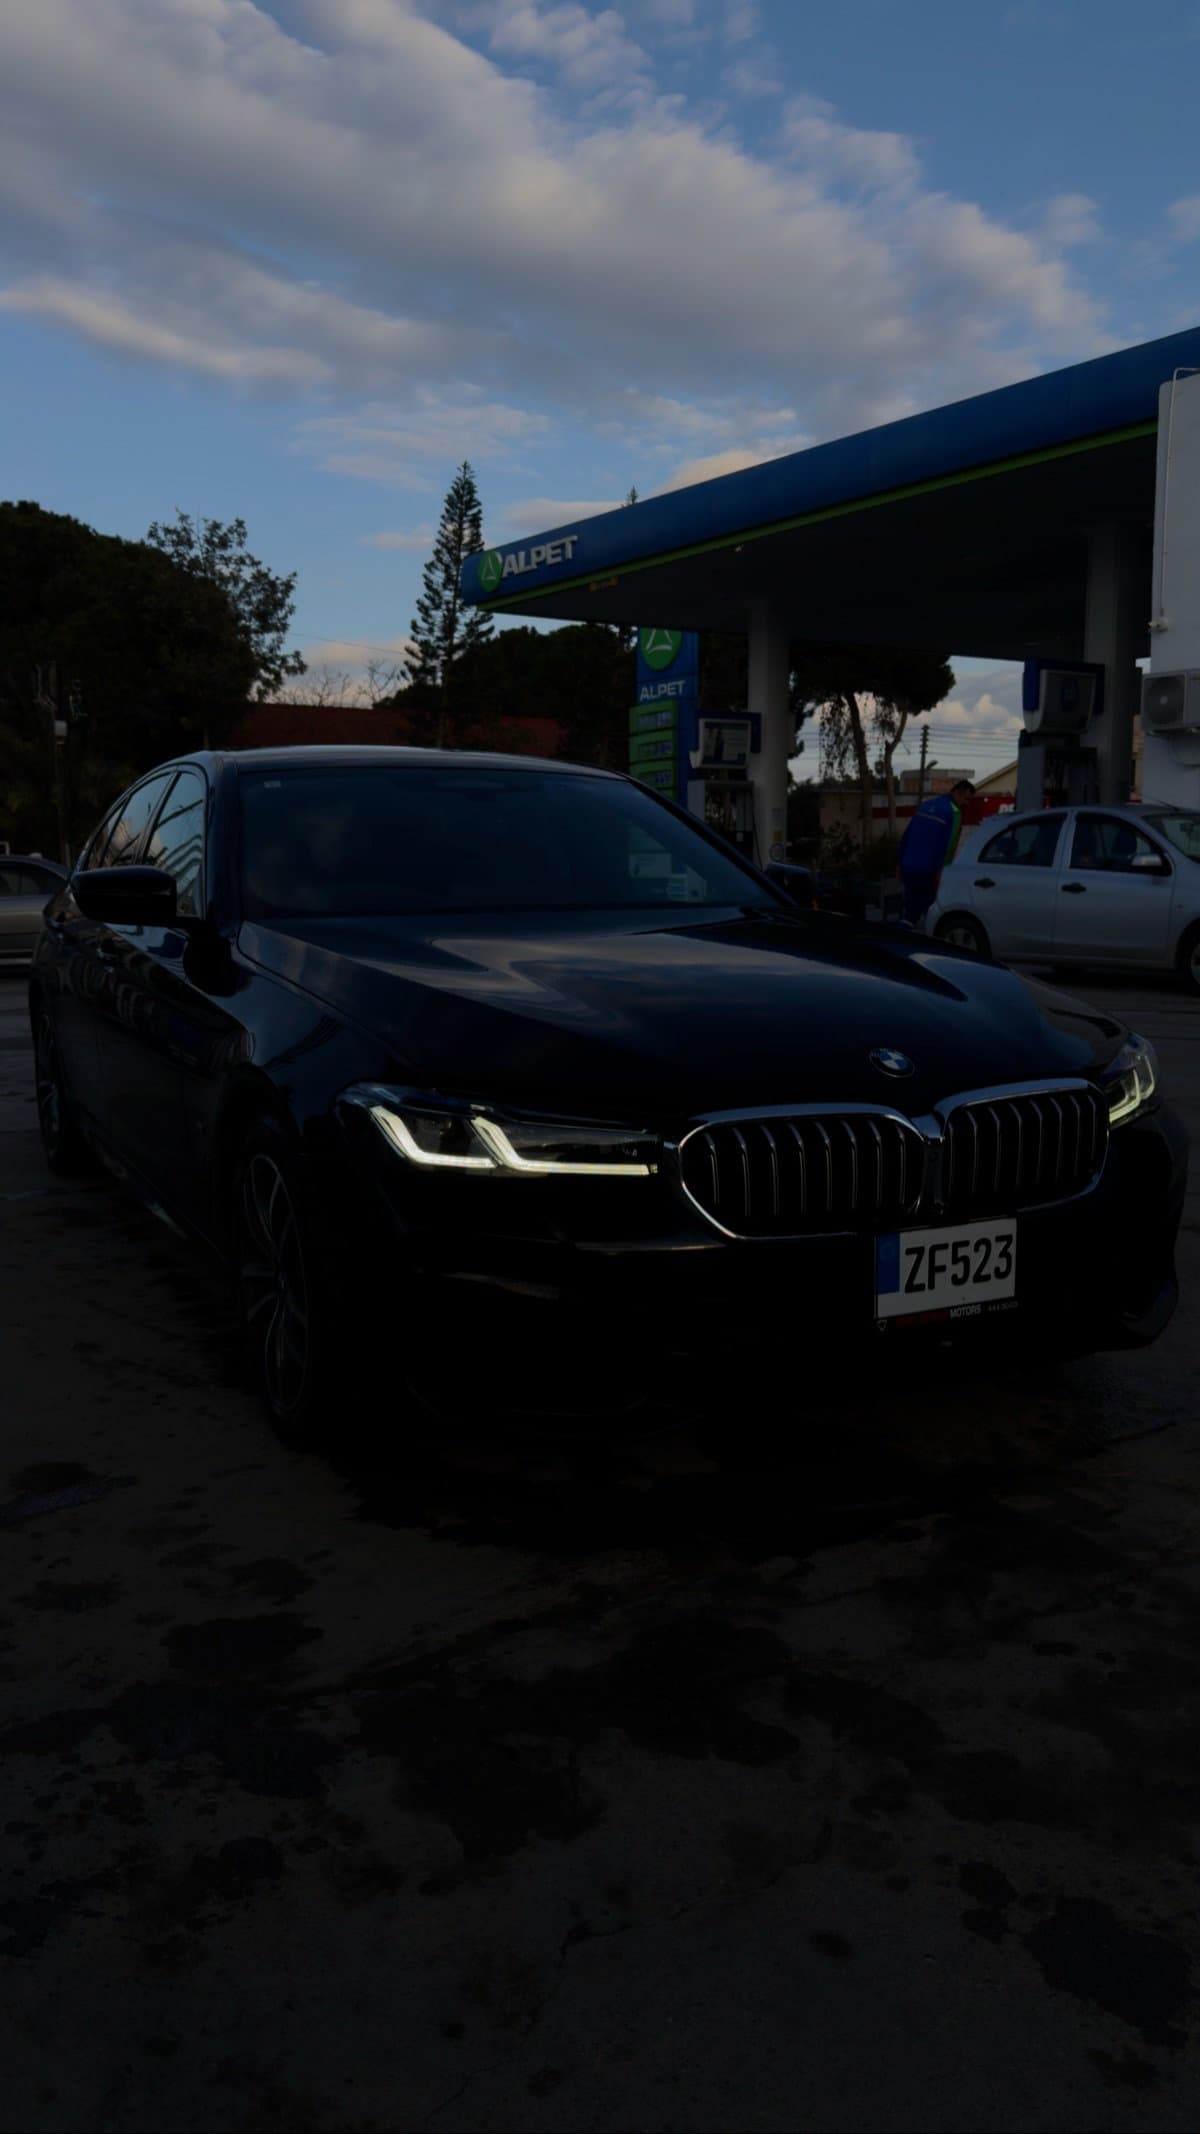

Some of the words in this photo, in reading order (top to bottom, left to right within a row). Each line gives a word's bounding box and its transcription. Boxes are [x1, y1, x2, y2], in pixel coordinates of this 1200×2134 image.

[502, 536, 578, 578] ALPET
[640, 680, 687, 701] ALPET
[905, 1235, 1013, 1293] ZF523
